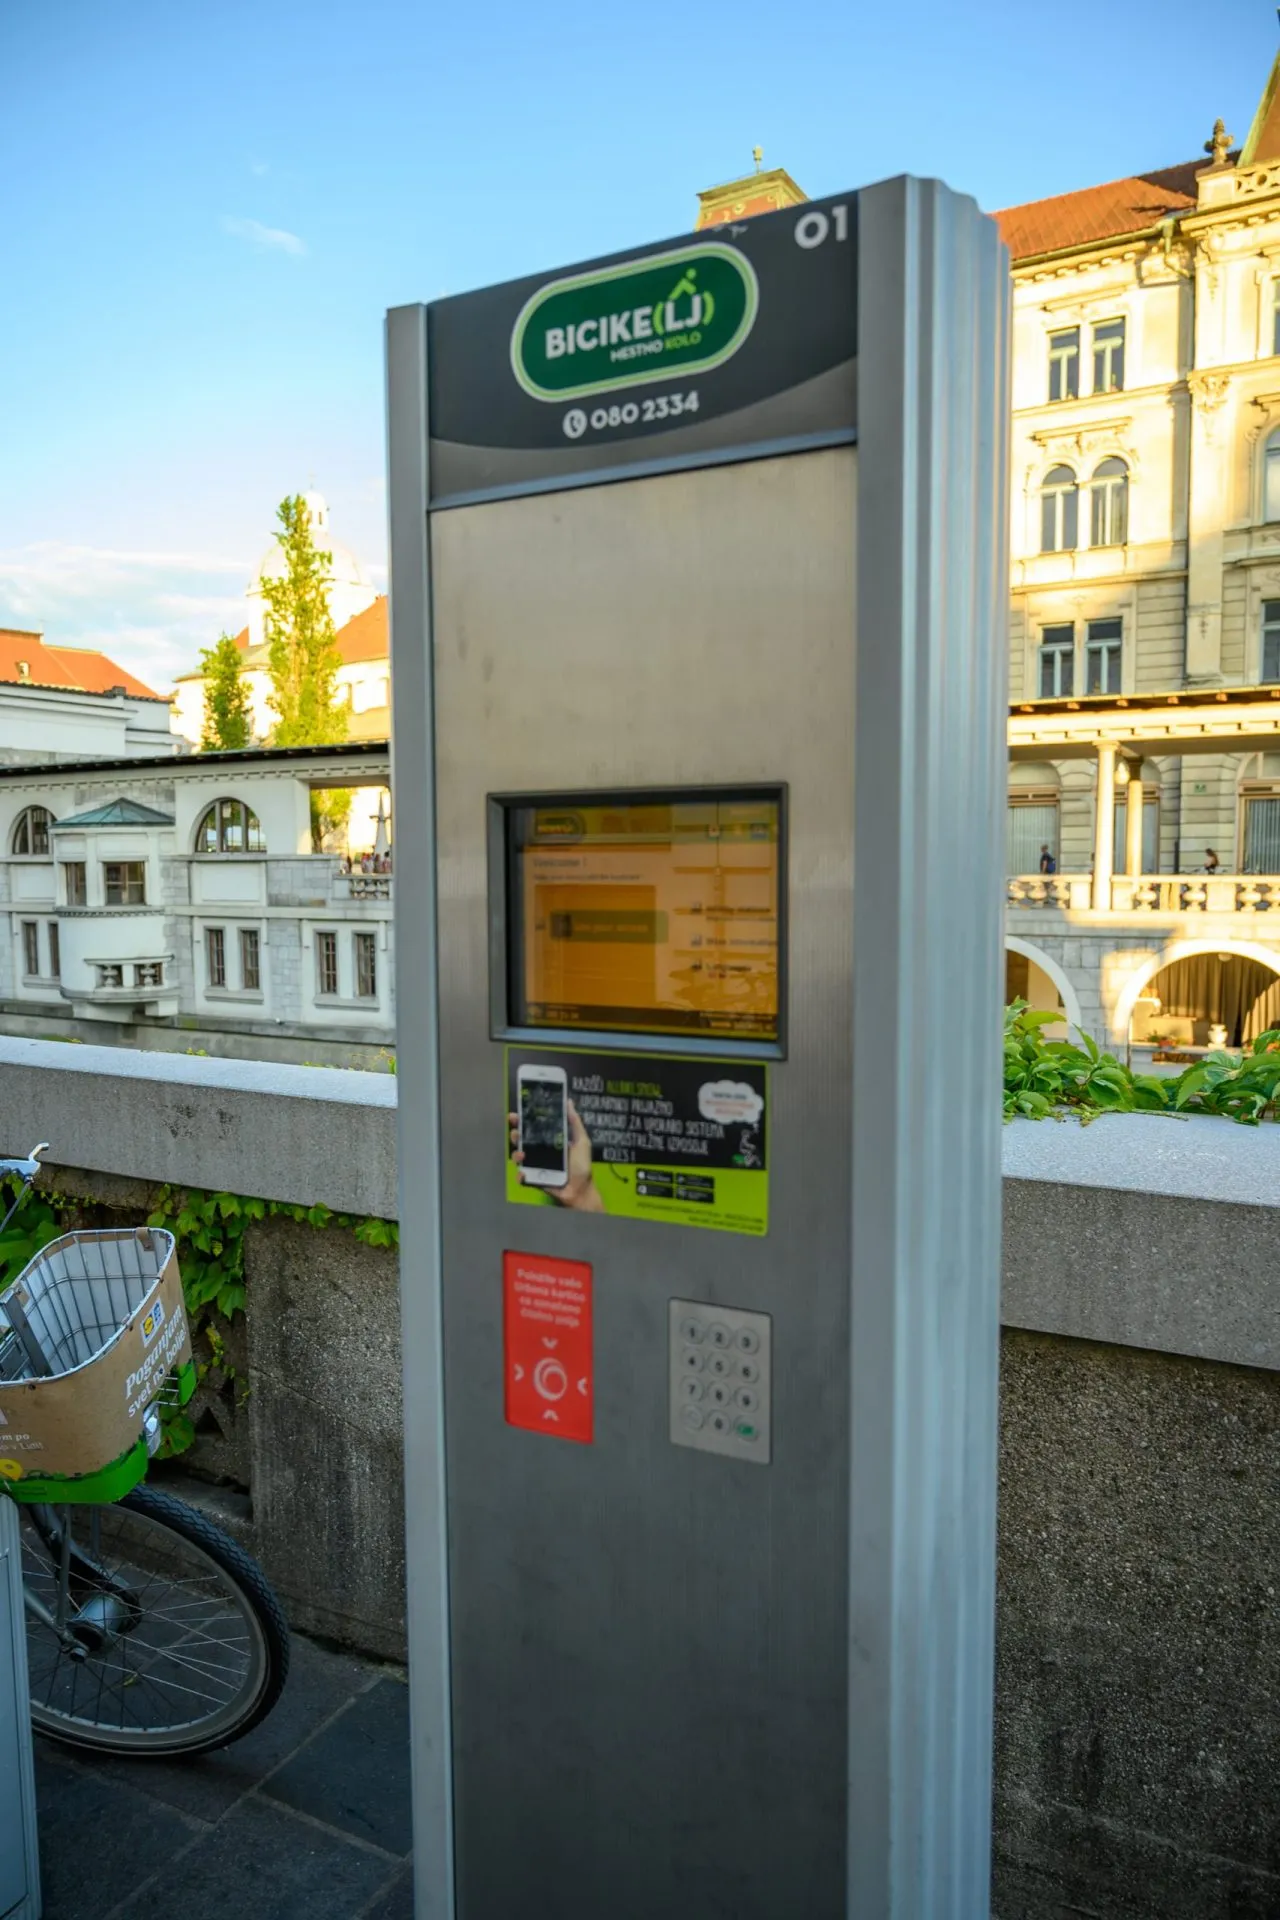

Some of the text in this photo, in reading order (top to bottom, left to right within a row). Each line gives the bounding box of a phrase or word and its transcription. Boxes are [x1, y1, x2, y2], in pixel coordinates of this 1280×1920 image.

[610, 330, 703, 363] MESTNO KOLO
[590, 390, 700, 431] 080 2334
[125, 1304, 182, 1400] Poganjam
[128, 1381, 152, 1418] svet
[15, 1433, 30, 1442] po
